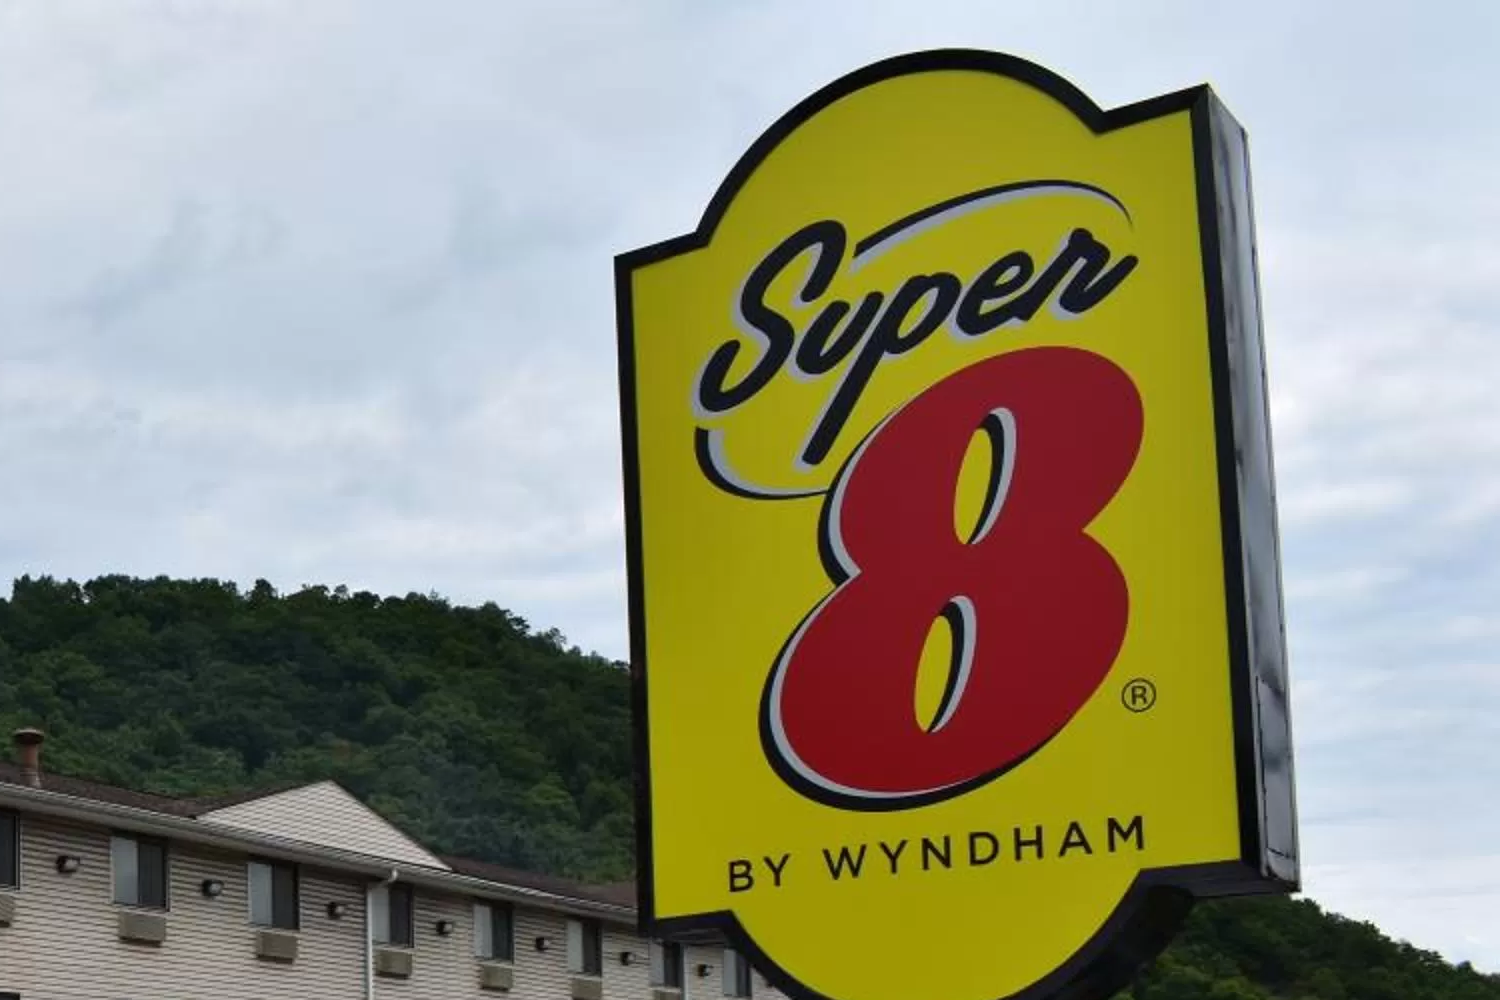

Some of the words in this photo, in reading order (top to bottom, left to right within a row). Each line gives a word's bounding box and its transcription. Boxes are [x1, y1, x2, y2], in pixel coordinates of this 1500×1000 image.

[696, 219, 1138, 467] Super
[759, 345, 1144, 812] 8
[728, 853, 791, 892] BY
[821, 815, 1146, 881] WYNDHAM
